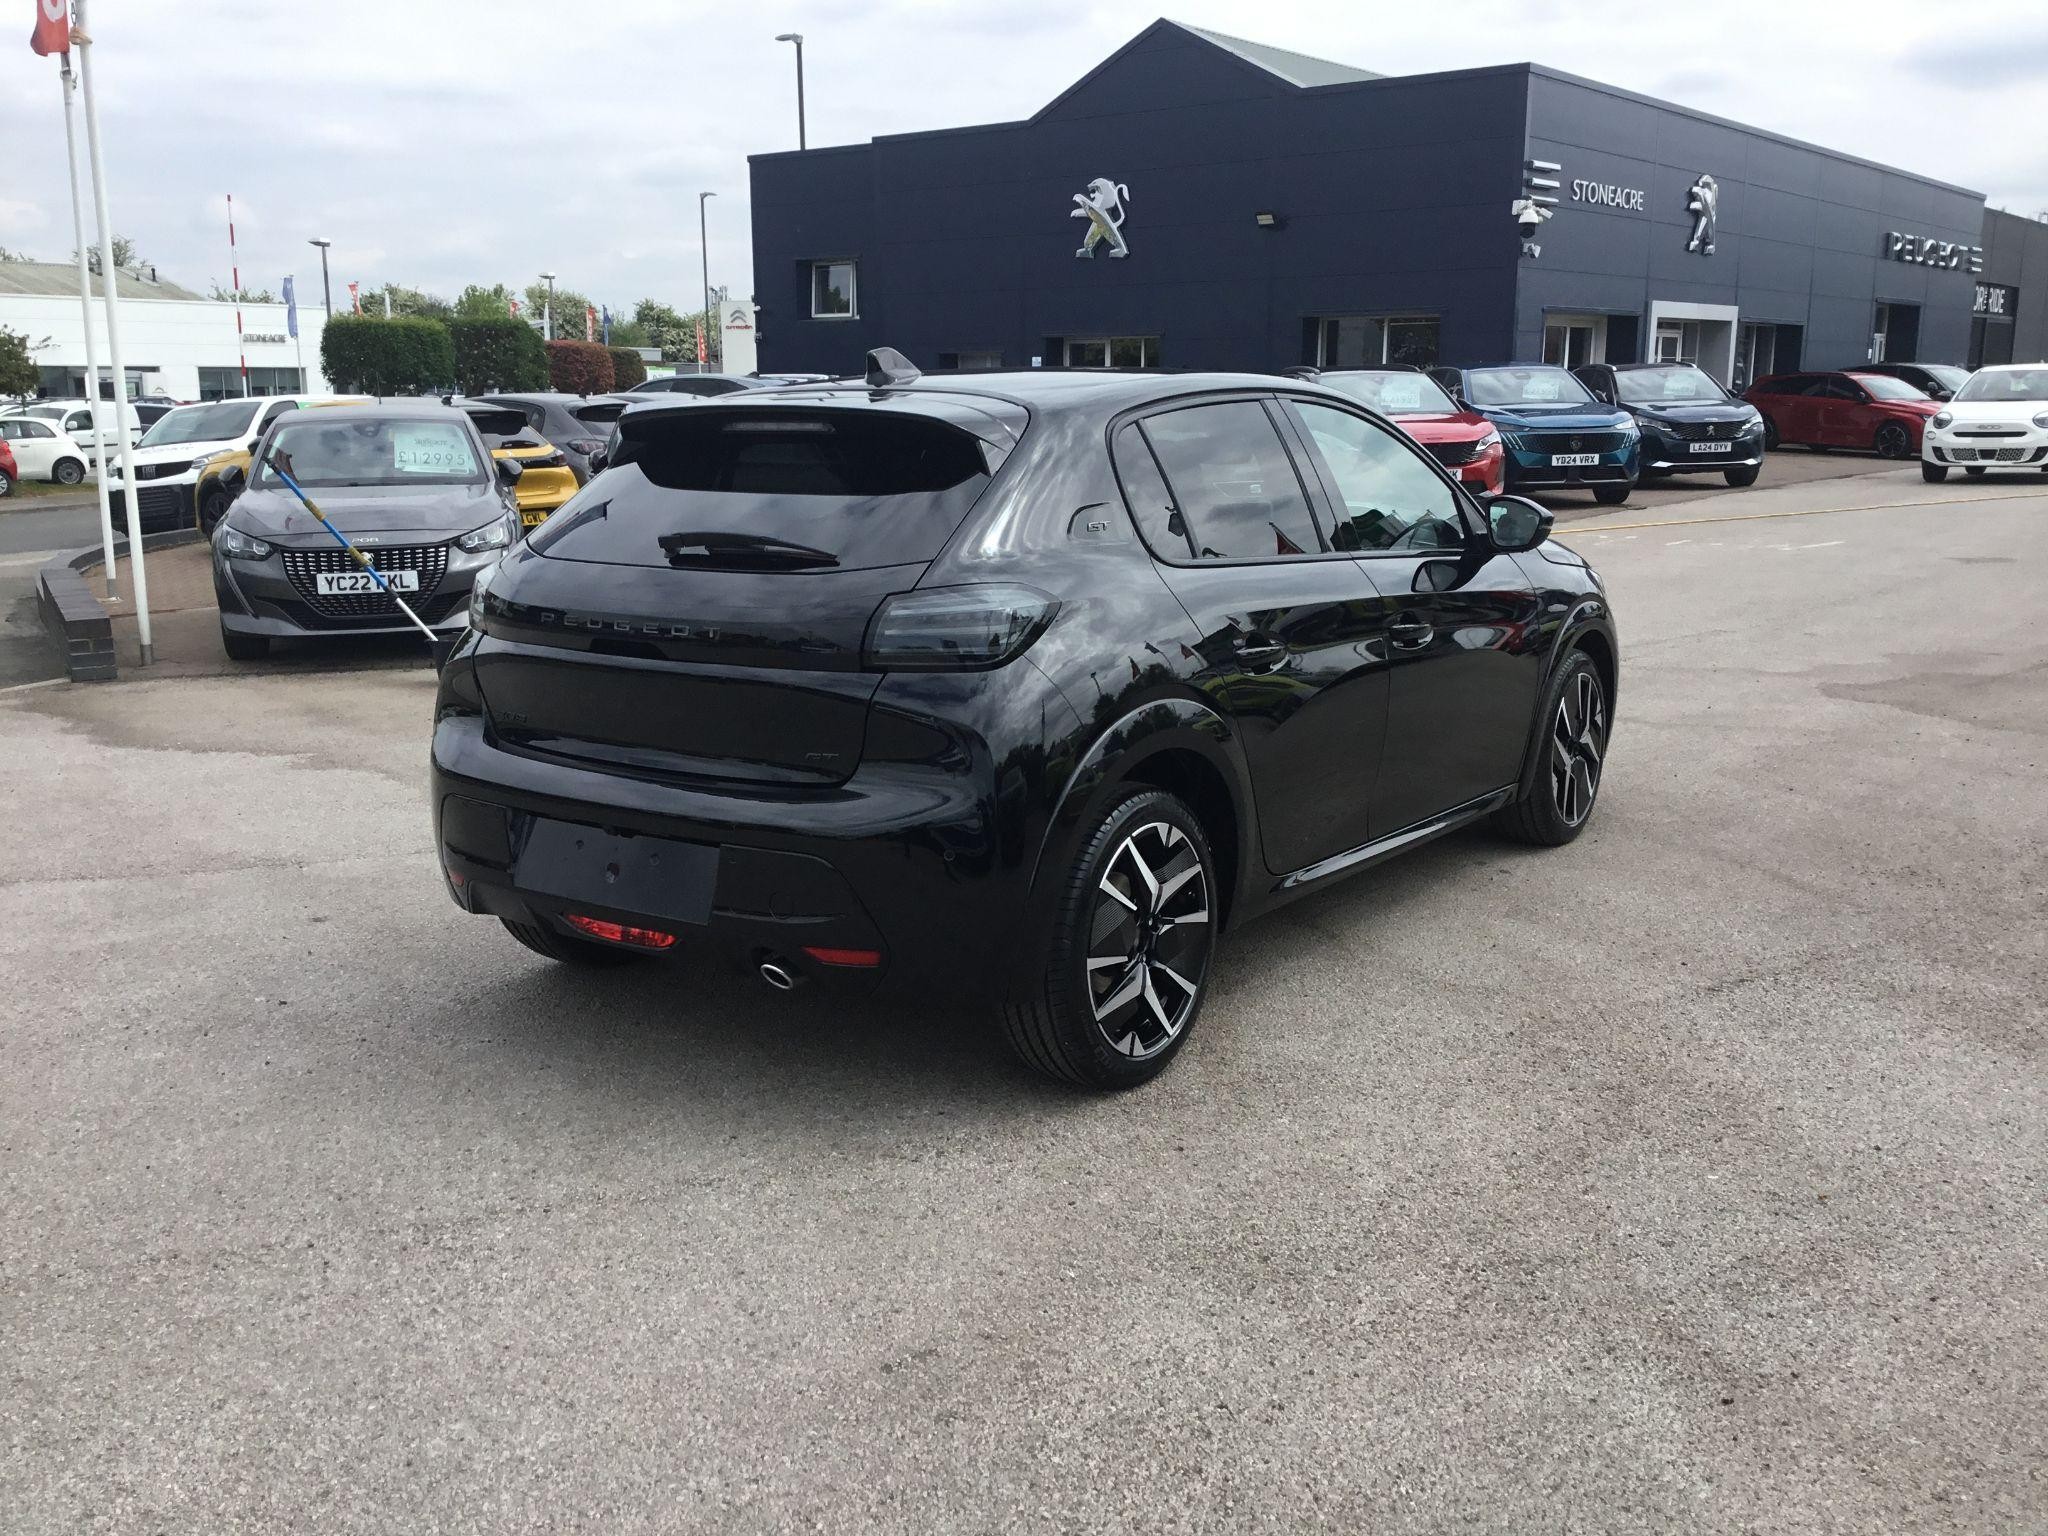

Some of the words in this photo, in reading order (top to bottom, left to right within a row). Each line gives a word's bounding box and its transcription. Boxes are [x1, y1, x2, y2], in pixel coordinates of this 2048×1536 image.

[1572, 178, 1645, 211] STONEACRE
[1886, 231, 1969, 269] PEUGEOT
[398, 450, 466, 466] £12995
[1555, 455, 1577, 465] YD24
[1580, 455, 1596, 464] VRX
[324, 574, 371, 592] YC22
[540, 611, 721, 640] PEUGEOT
